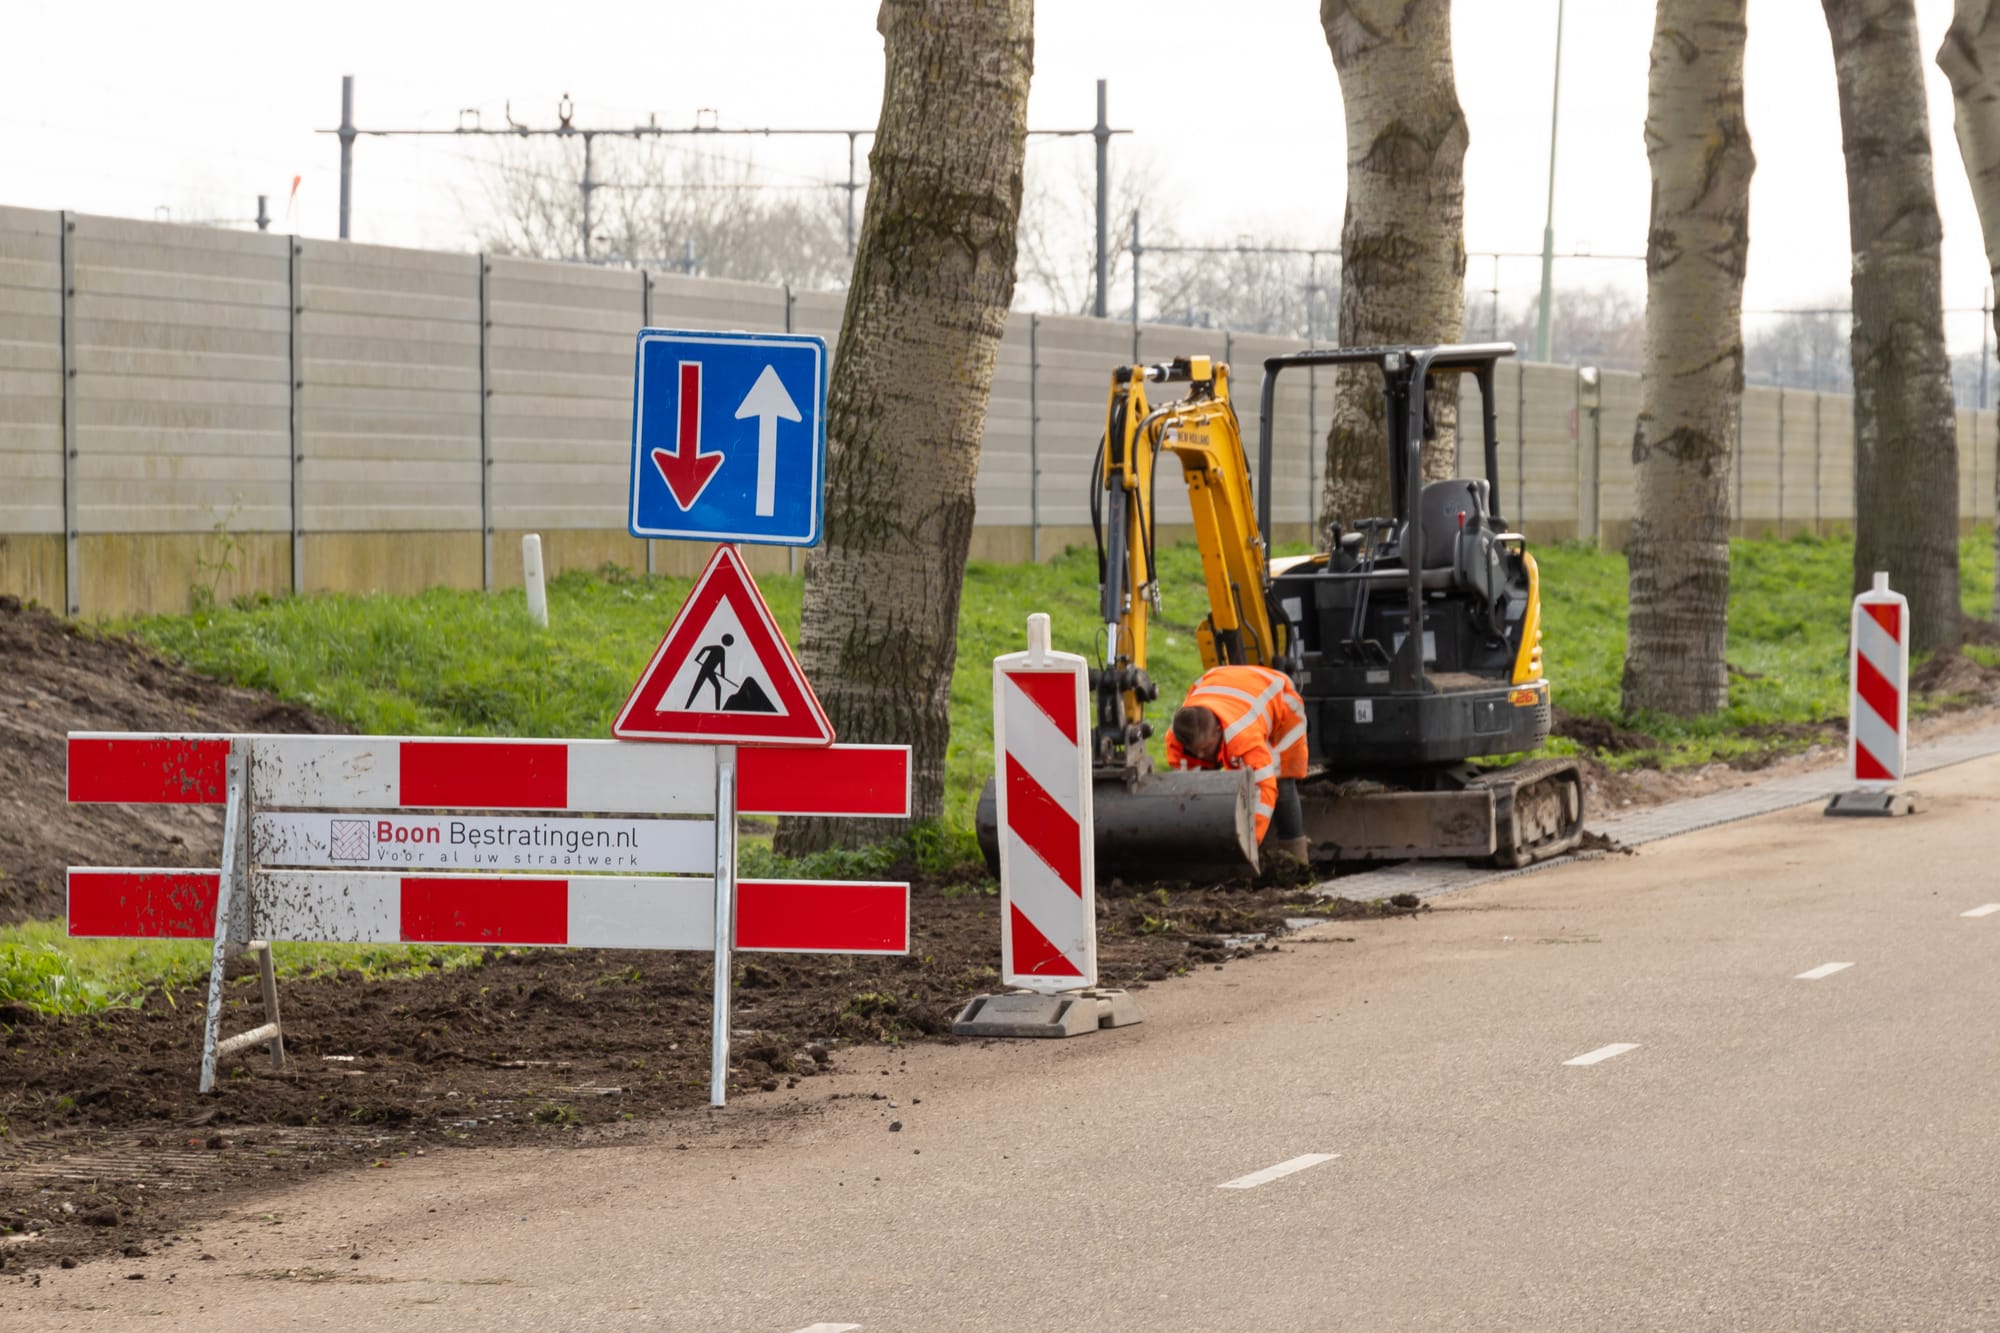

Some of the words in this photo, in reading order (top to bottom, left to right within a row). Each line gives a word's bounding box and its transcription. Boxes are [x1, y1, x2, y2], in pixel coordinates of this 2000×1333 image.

[377, 820, 440, 844] Boon
[450, 821, 639, 854] Bestratingen.nl
[377, 849, 425, 862] Voor
[440, 850, 459, 863] al
[475, 853, 498, 864] uw
[513, 853, 639, 866] straatwerk
